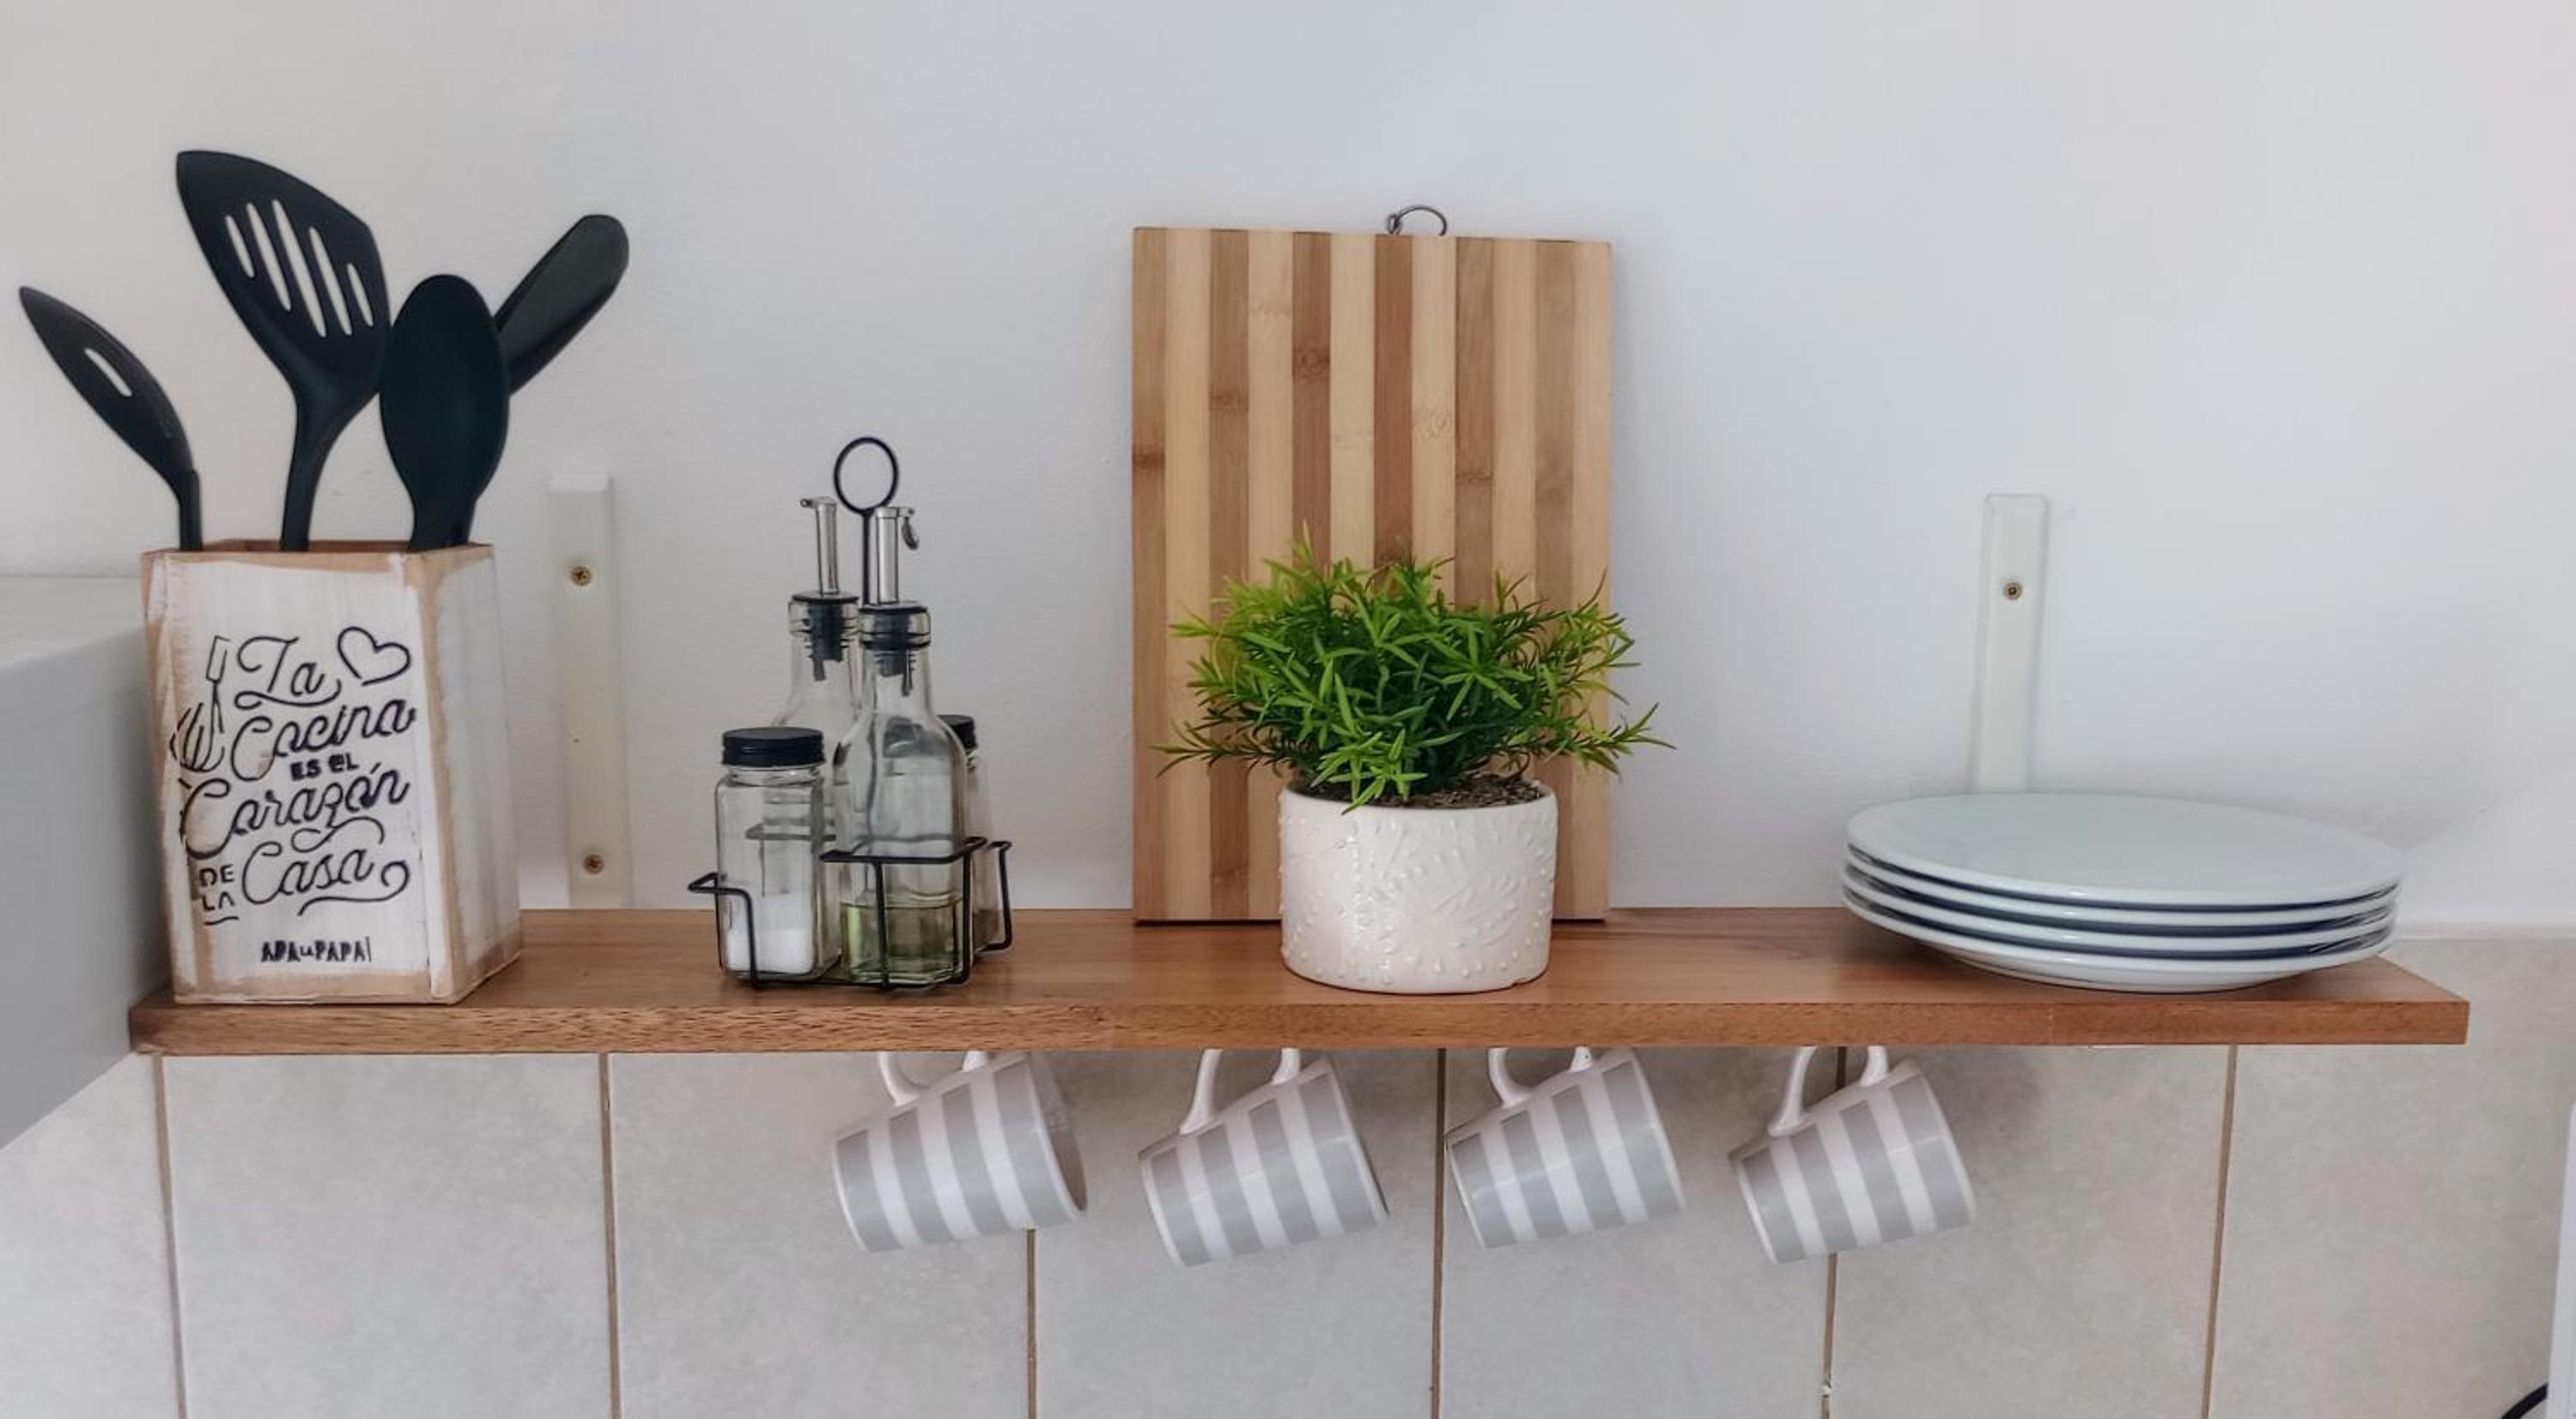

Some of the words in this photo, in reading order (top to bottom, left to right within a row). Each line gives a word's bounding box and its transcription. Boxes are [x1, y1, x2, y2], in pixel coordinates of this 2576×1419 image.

[290, 759, 322, 782] ES
[198, 863, 235, 887] DE
[242, 841, 374, 904] Casa
[202, 892, 236, 911] LA
